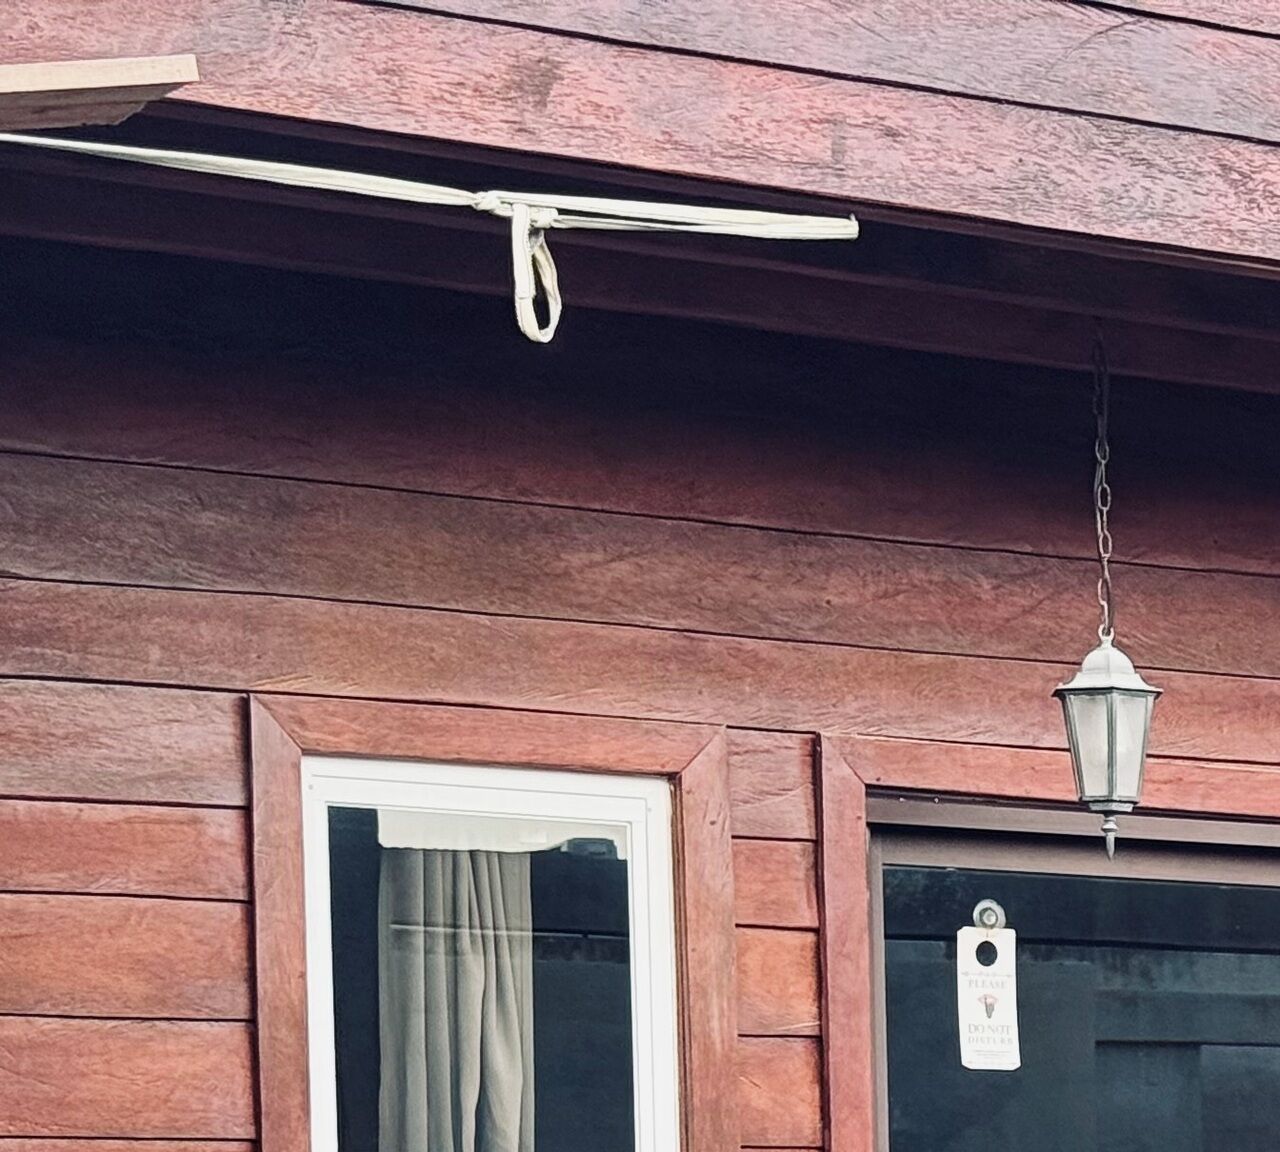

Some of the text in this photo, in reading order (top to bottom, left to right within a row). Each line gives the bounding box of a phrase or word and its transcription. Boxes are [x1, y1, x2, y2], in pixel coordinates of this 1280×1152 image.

[967, 978, 1007, 990] PLEASE
[967, 1023, 1012, 1036] DO NOT
